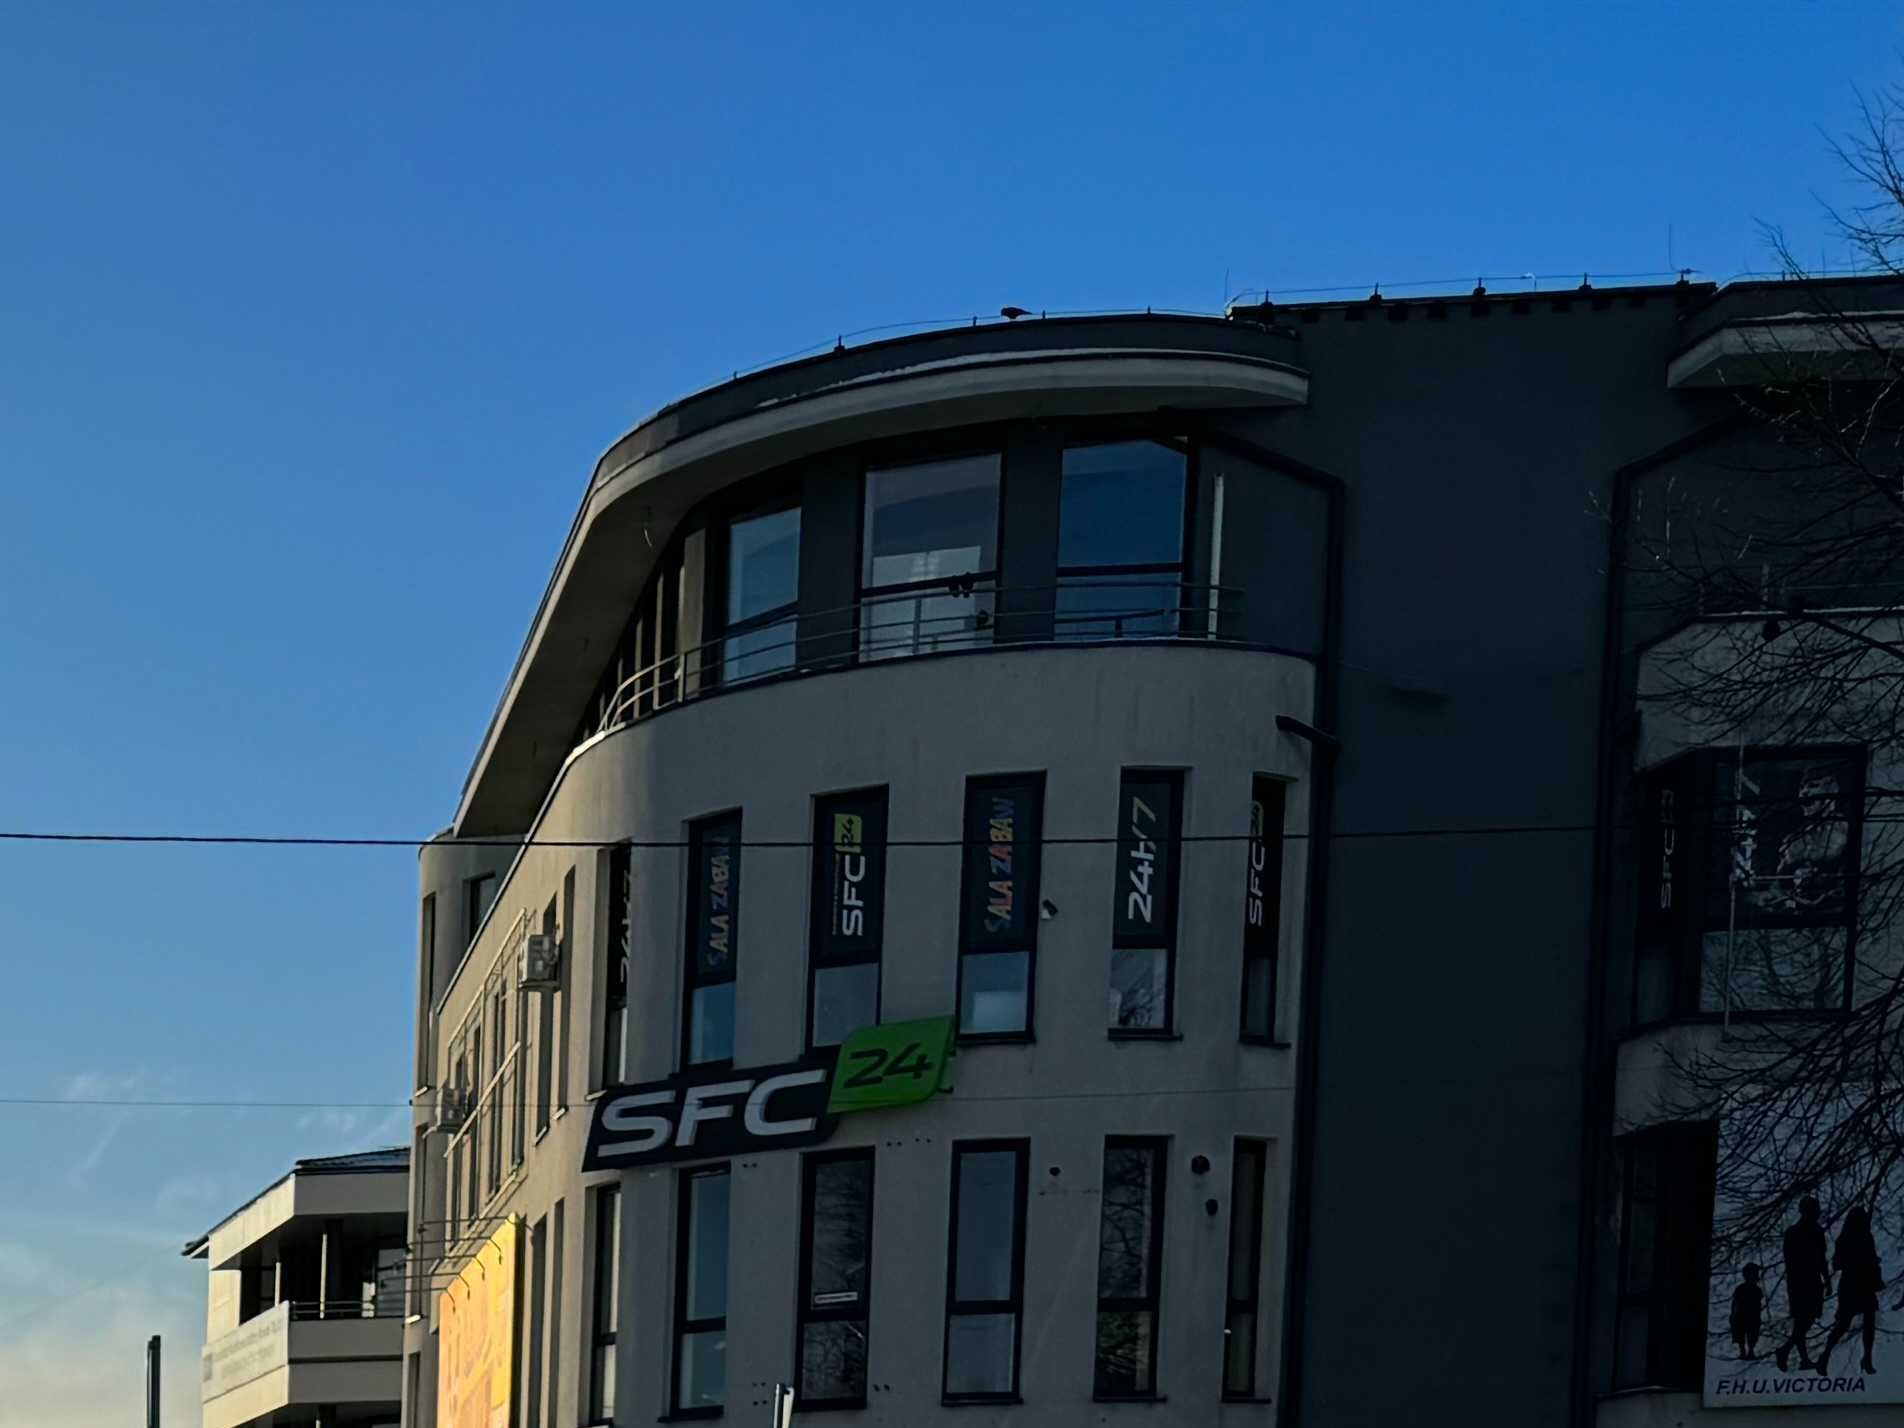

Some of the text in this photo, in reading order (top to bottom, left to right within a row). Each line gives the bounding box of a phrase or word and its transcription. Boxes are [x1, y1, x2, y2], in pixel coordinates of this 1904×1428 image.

[841, 815, 866, 937] SFC 24
[984, 798, 1015, 932] SALA ZABAW
[1127, 796, 1156, 923] 24h/7
[1249, 841, 1266, 927] SFC
[705, 915, 729, 967] SALA
[597, 1042, 935, 1158] SFC 24
